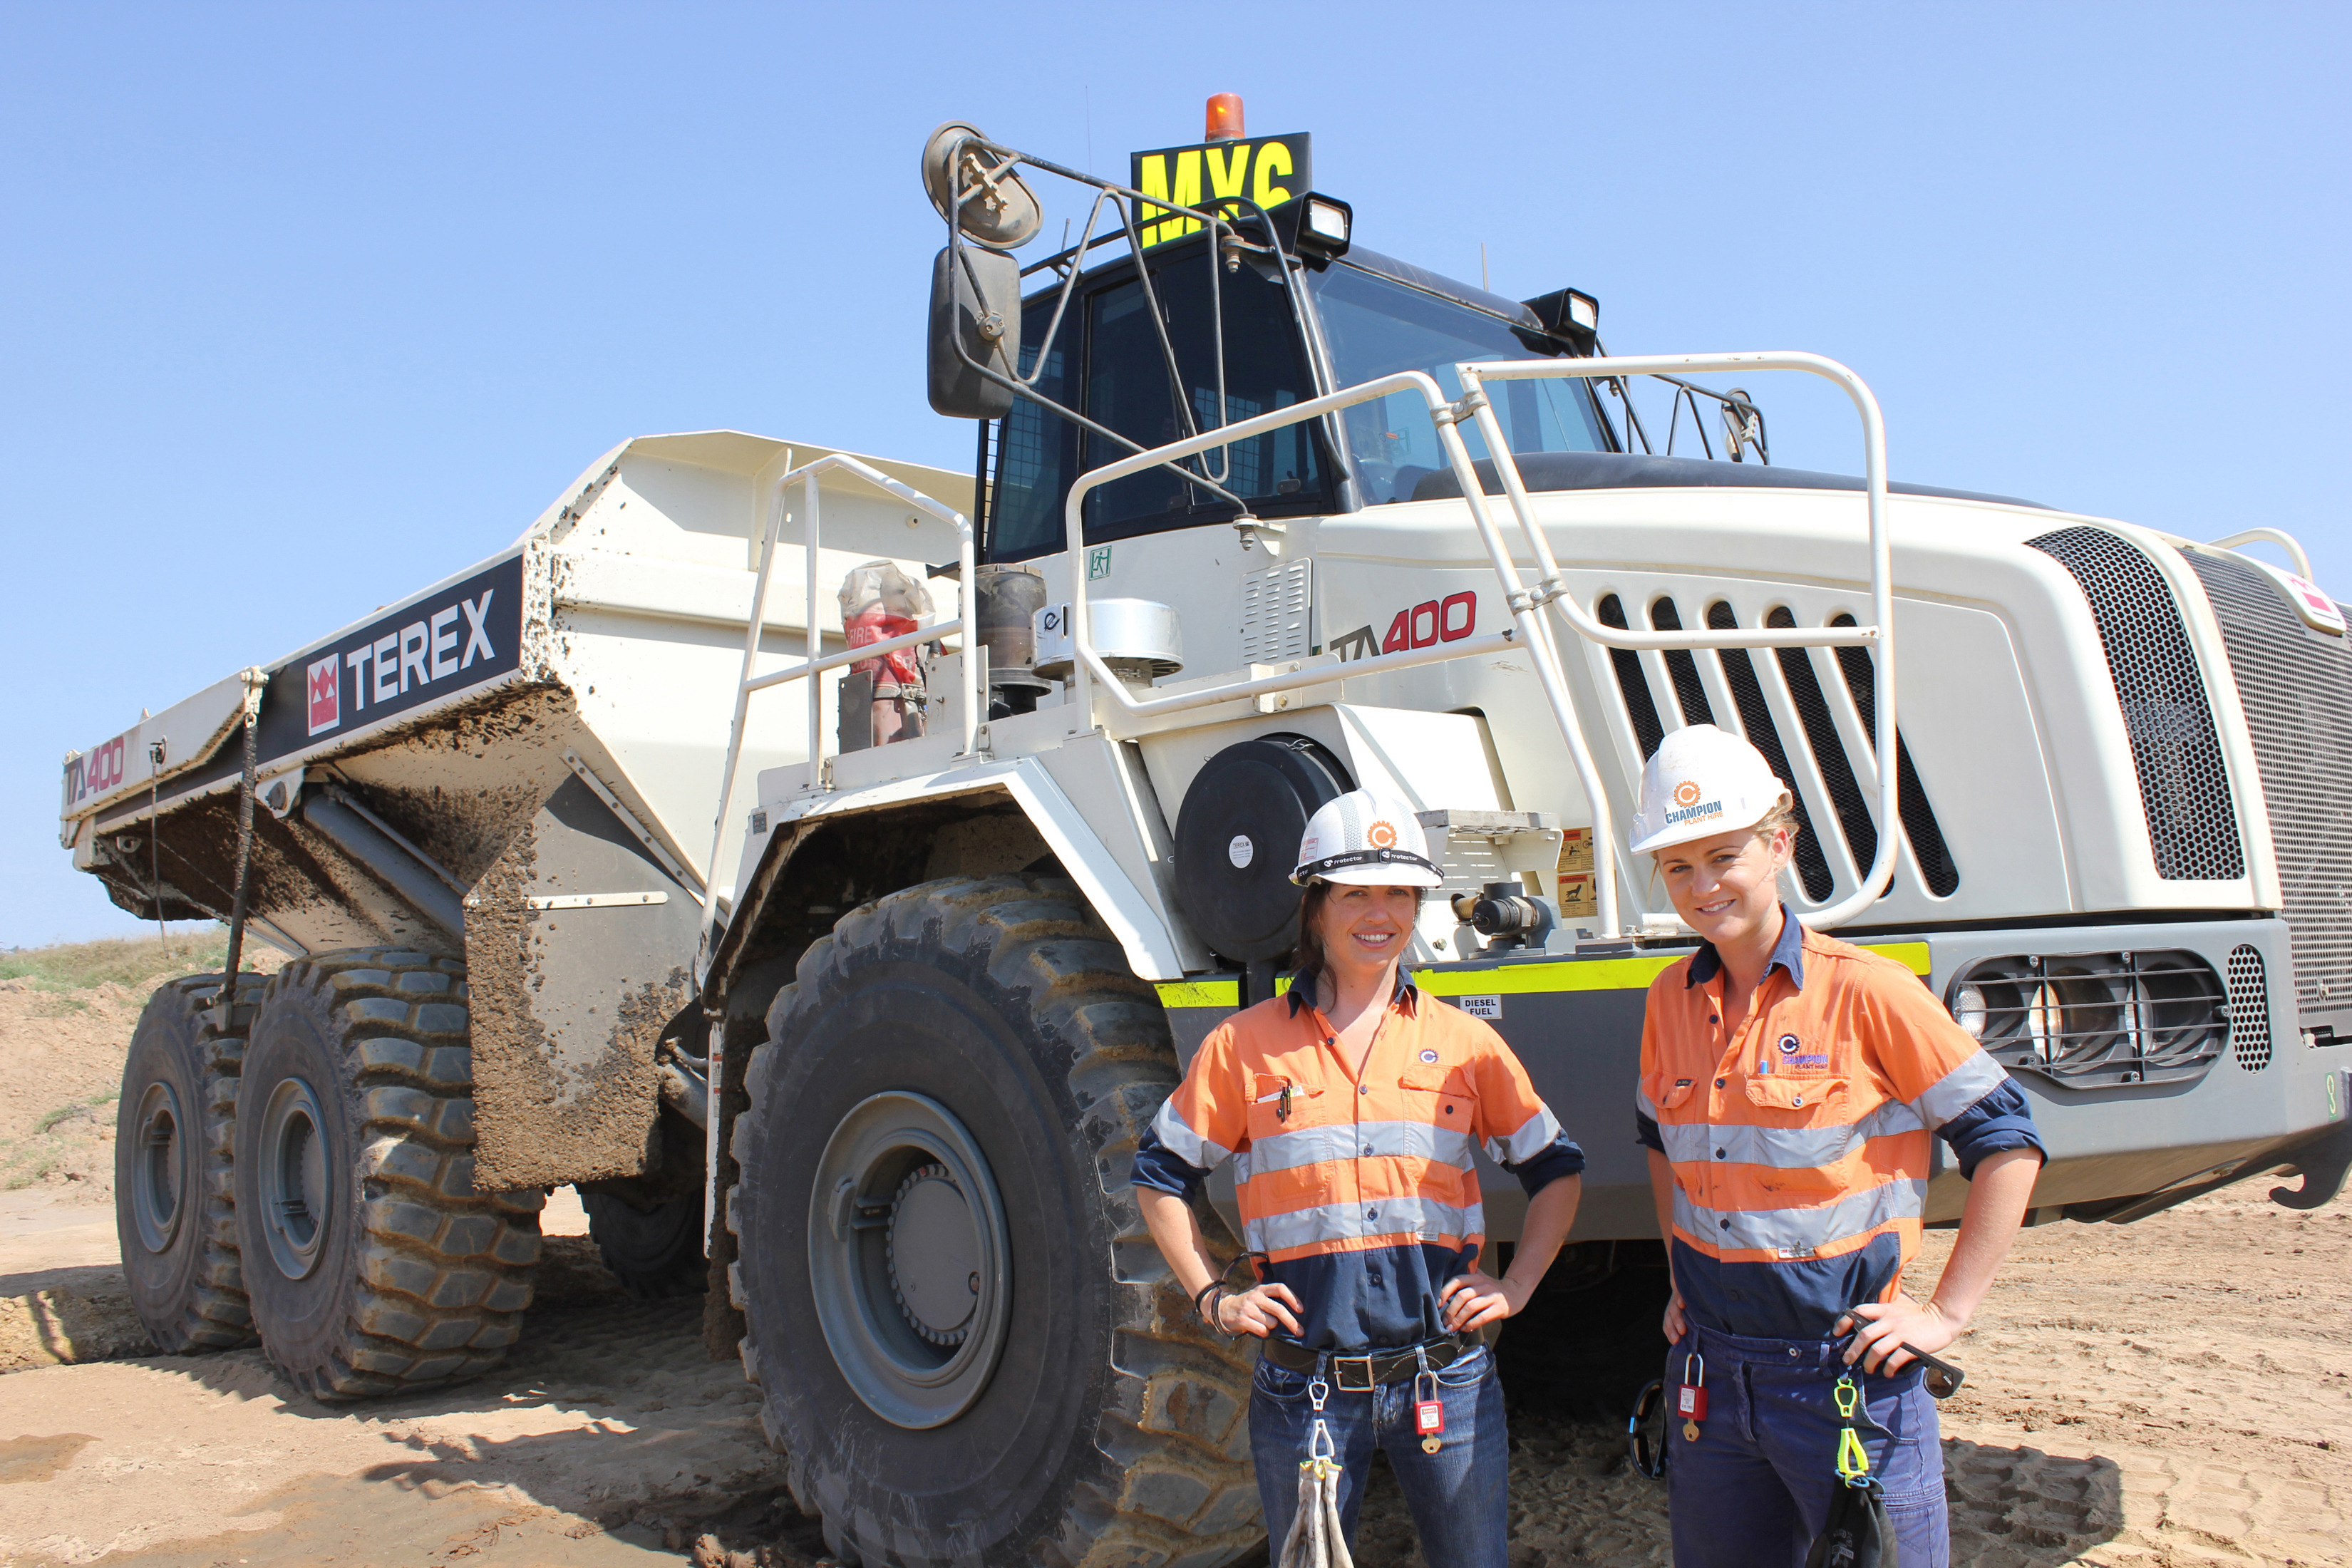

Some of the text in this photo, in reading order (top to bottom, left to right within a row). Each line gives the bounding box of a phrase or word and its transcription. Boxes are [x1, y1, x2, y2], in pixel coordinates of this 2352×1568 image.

[849, 626, 873, 644] FIRE
[1330, 591, 1476, 662] TA400
[346, 588, 495, 711] TEREX
[64, 736, 124, 805] TA400
[1666, 800, 1722, 825] CHAMPION
[1684, 811, 1723, 826] PLANT HIRE
[1465, 999, 1496, 1007] DIESEL
[1783, 1054, 1828, 1065] CHAMPION
